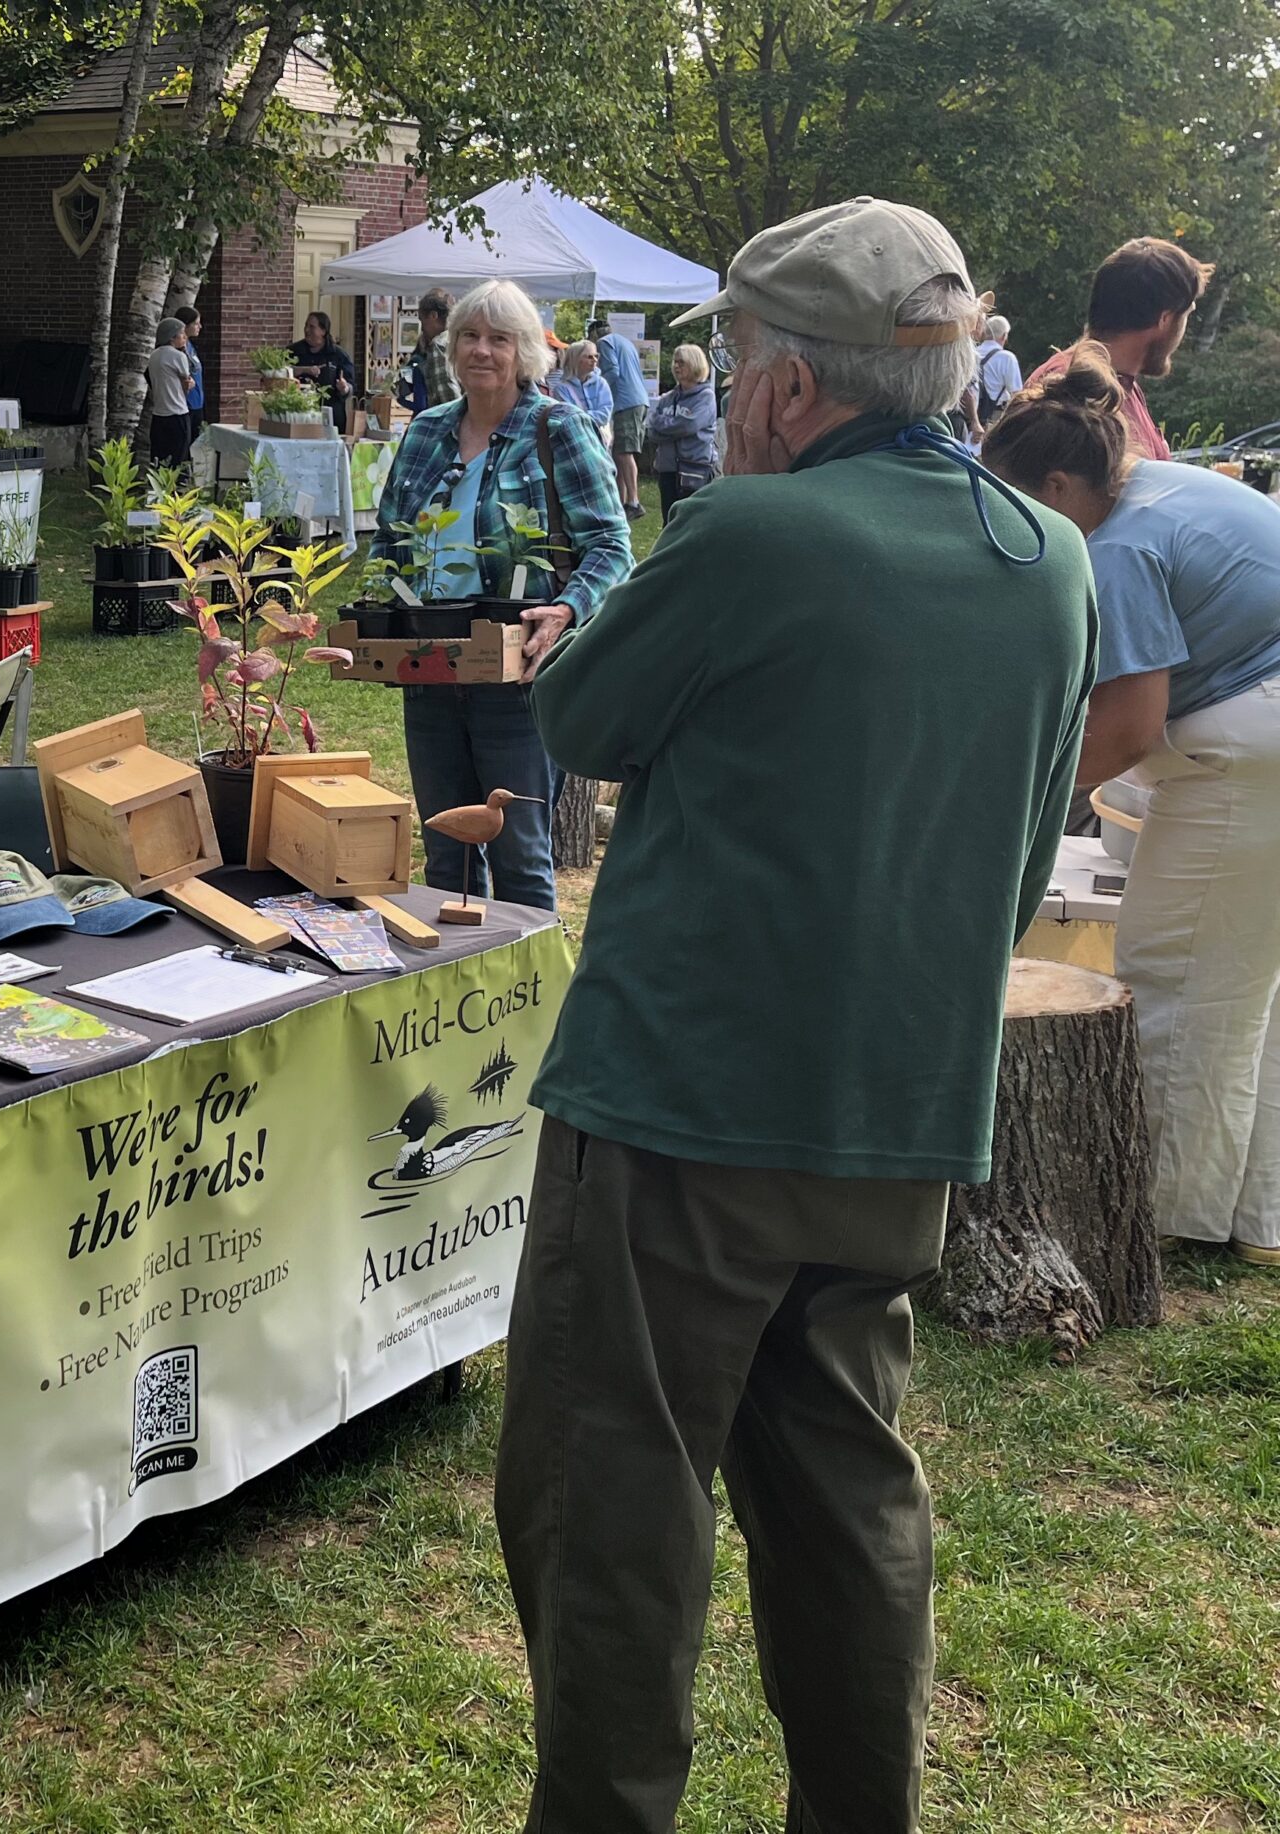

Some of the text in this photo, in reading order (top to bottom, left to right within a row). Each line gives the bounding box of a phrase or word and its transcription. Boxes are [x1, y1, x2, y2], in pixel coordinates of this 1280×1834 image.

[370, 971, 542, 1065] Mid-Coast
[77, 1072, 258, 1181] We're for
[68, 1128, 267, 1259] the birds!
[97, 1227, 263, 1318] Free Field Trips
[360, 1194, 527, 1304] Audubon
[58, 1259, 289, 1389] Free Nature Programs
[377, 1285, 500, 1354] midcoast.maineaudubon.org
[401, 1299, 422, 1318] Chapter
[422, 1294, 431, 1306] of
[430, 1287, 447, 1302] Maine
[448, 1275, 477, 1293] Audubon
[137, 1455, 185, 1480] SCAN ME
